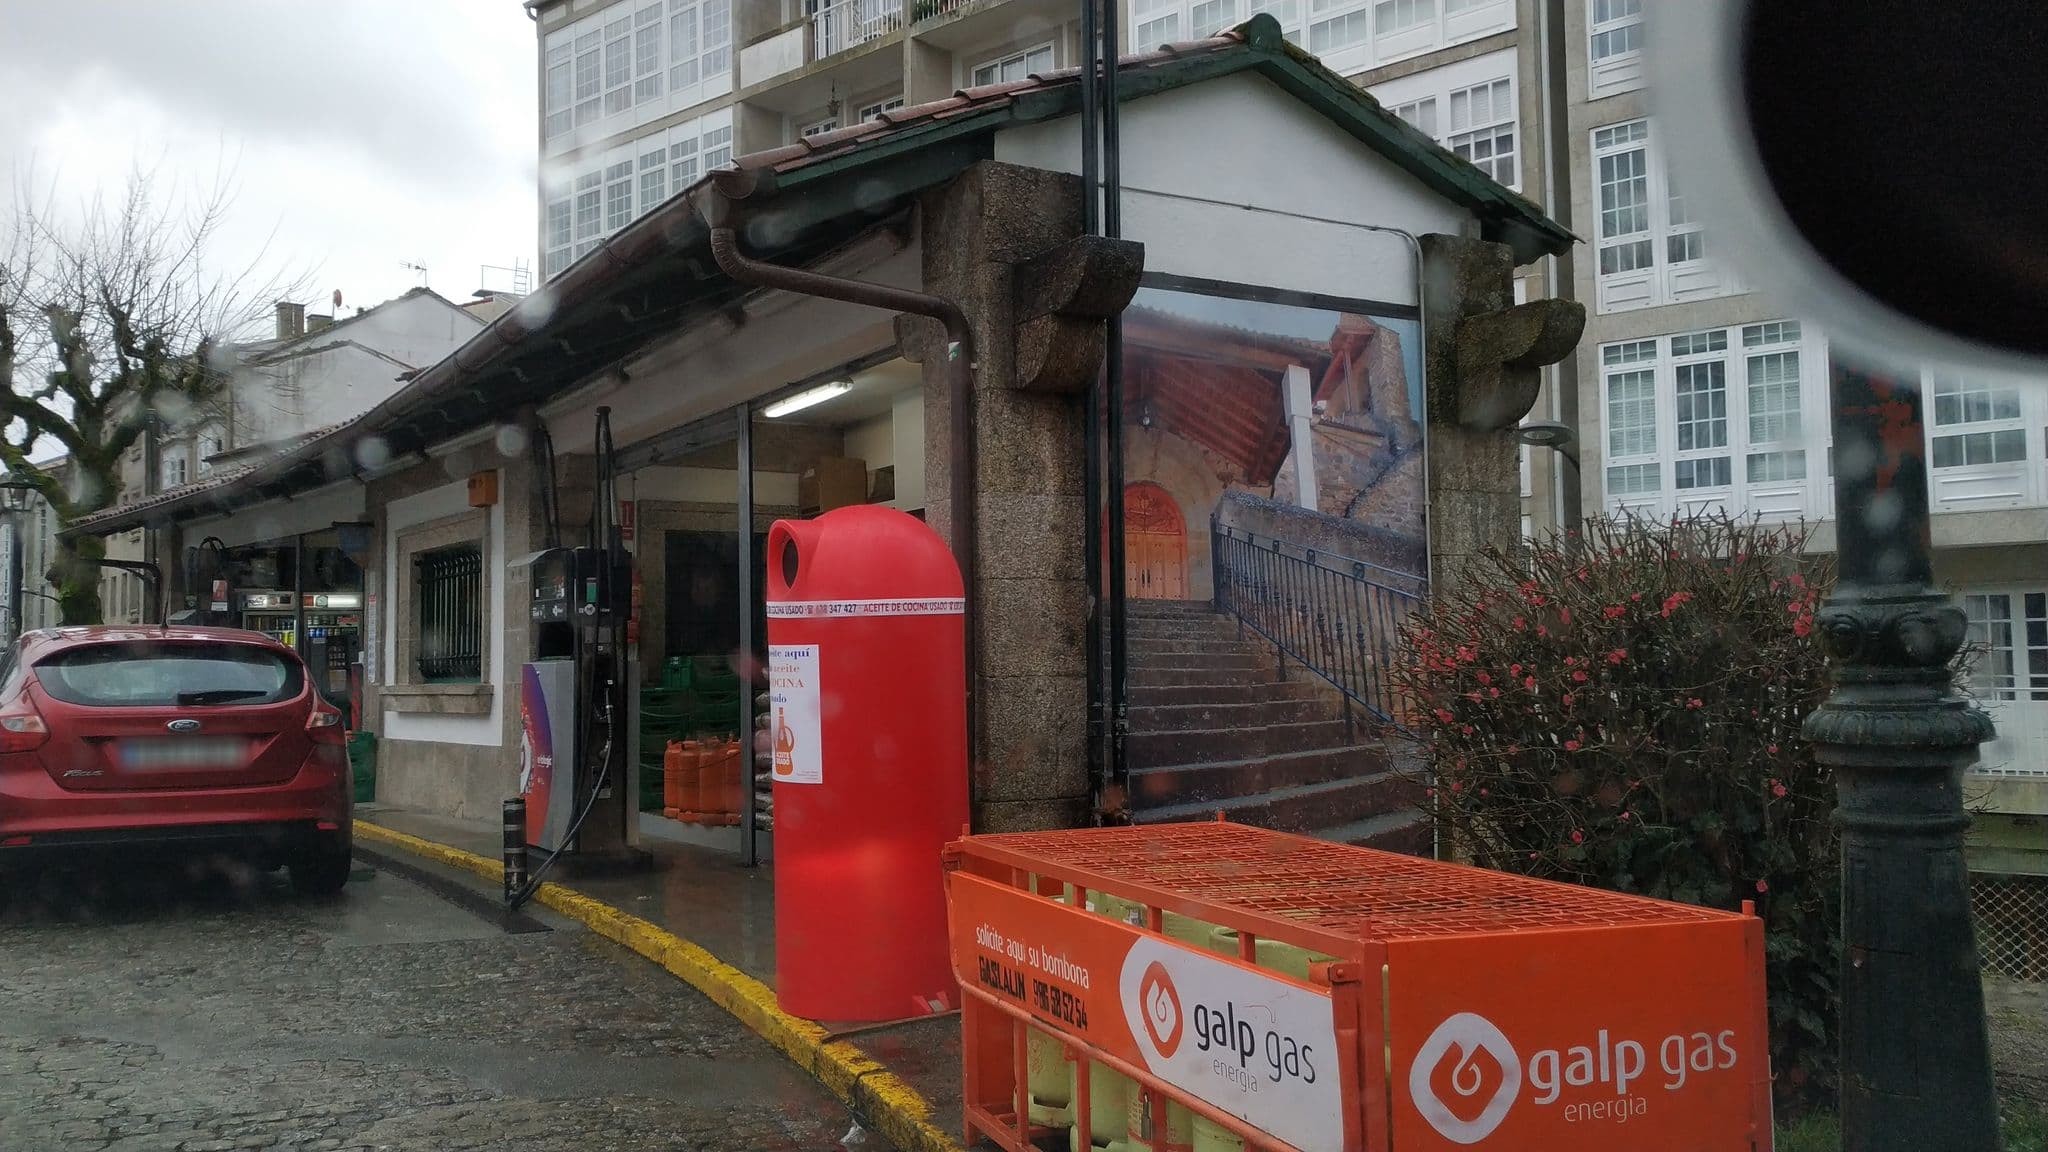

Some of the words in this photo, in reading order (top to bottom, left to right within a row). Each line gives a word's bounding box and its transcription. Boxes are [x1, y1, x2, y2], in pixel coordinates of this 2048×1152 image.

[829, 604, 842, 614] 347
[844, 603, 857, 613] 427
[864, 603, 890, 613] ACEITE
[891, 602, 901, 612] DE
[902, 601, 928, 612] COCINA
[929, 601, 948, 611] USADO
[784, 648, 810, 660] aquí
[769, 678, 804, 688] OCINA
[976, 923, 1004, 954] solicite
[1028, 947, 1040, 969] su
[1041, 944, 1090, 990] bombona
[1062, 990, 1075, 1025] 52
[1075, 997, 1088, 1032] 54
[1193, 1000, 1256, 1069] galp
[1265, 1030, 1316, 1084] gas
[1213, 1059, 1258, 1093] energia
[1528, 1029, 1646, 1105] galp
[1659, 1029, 1737, 1090] gas
[1564, 1093, 1648, 1124] energia
